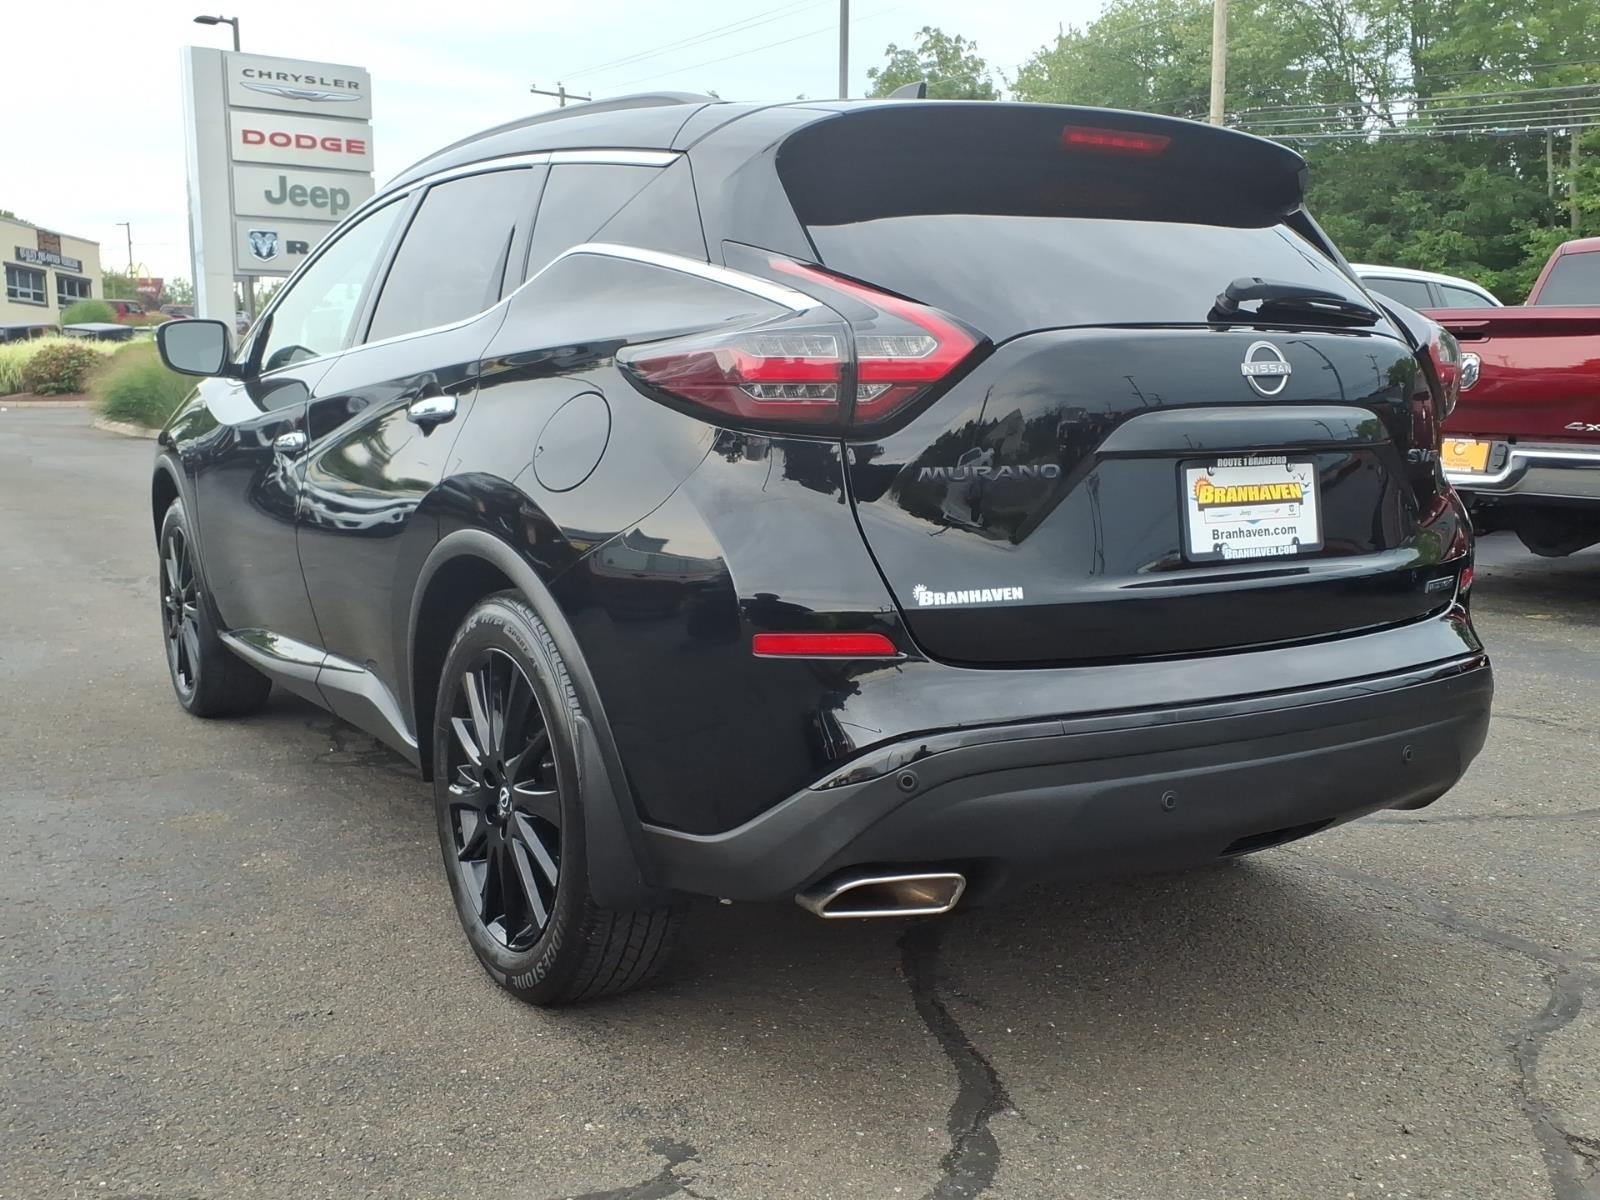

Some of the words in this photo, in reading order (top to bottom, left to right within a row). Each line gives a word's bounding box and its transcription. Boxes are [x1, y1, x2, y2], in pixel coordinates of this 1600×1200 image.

[242, 69, 360, 90] CHRYSLER
[241, 129, 366, 155] DODGE
[264, 175, 350, 215] Jeep
[1243, 362, 1292, 376] NISSAN
[1217, 458, 1242, 467] ROUTE
[1248, 456, 1287, 466] BRANFORD
[917, 463, 1060, 482] MURANO
[1198, 482, 1303, 505] BRANHAVEN
[1212, 525, 1297, 541] Branhaven.com
[1223, 544, 1298, 560] BRANHAVEN.COM
[918, 586, 1024, 607] BRANHAVEN
